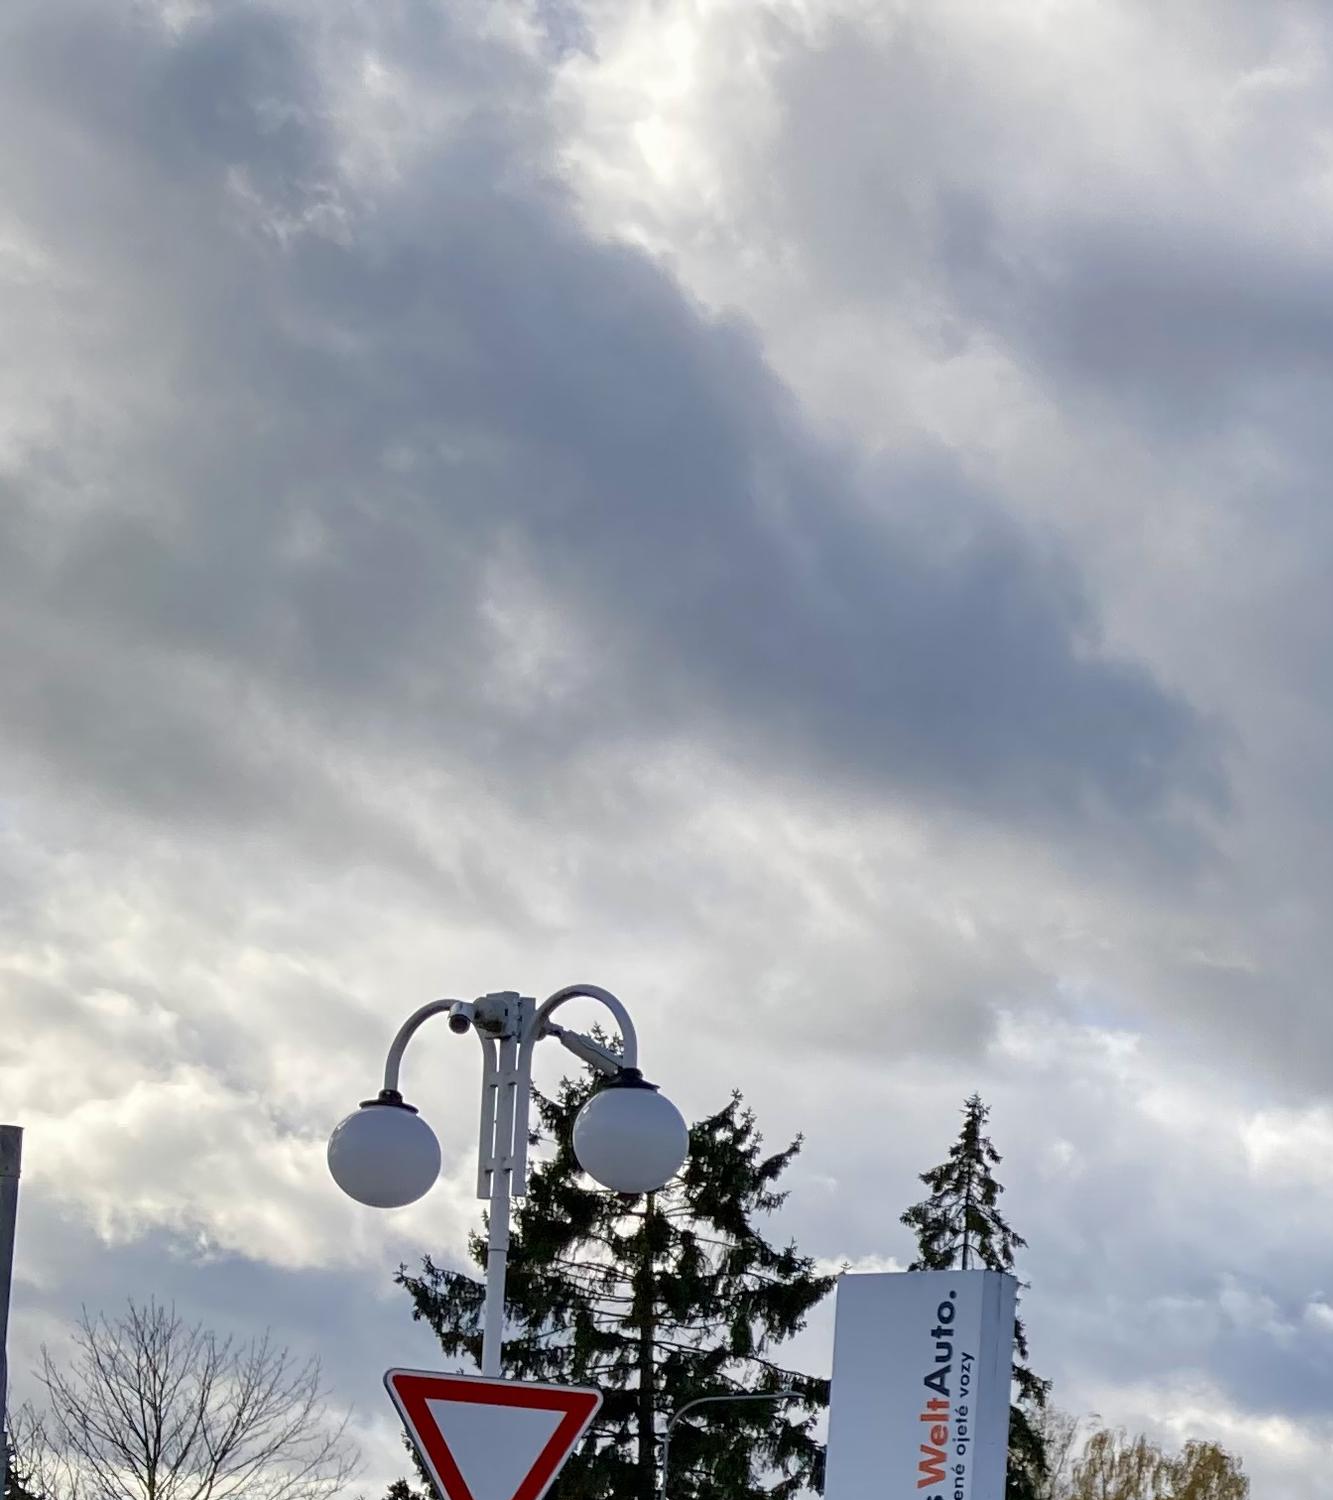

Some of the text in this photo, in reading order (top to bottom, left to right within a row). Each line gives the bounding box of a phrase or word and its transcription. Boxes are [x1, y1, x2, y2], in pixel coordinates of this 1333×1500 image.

[917, 1290, 957, 1489] WeltAuto.
[959, 1352, 975, 1398] vozy
[952, 1406, 970, 1456] ojeté
